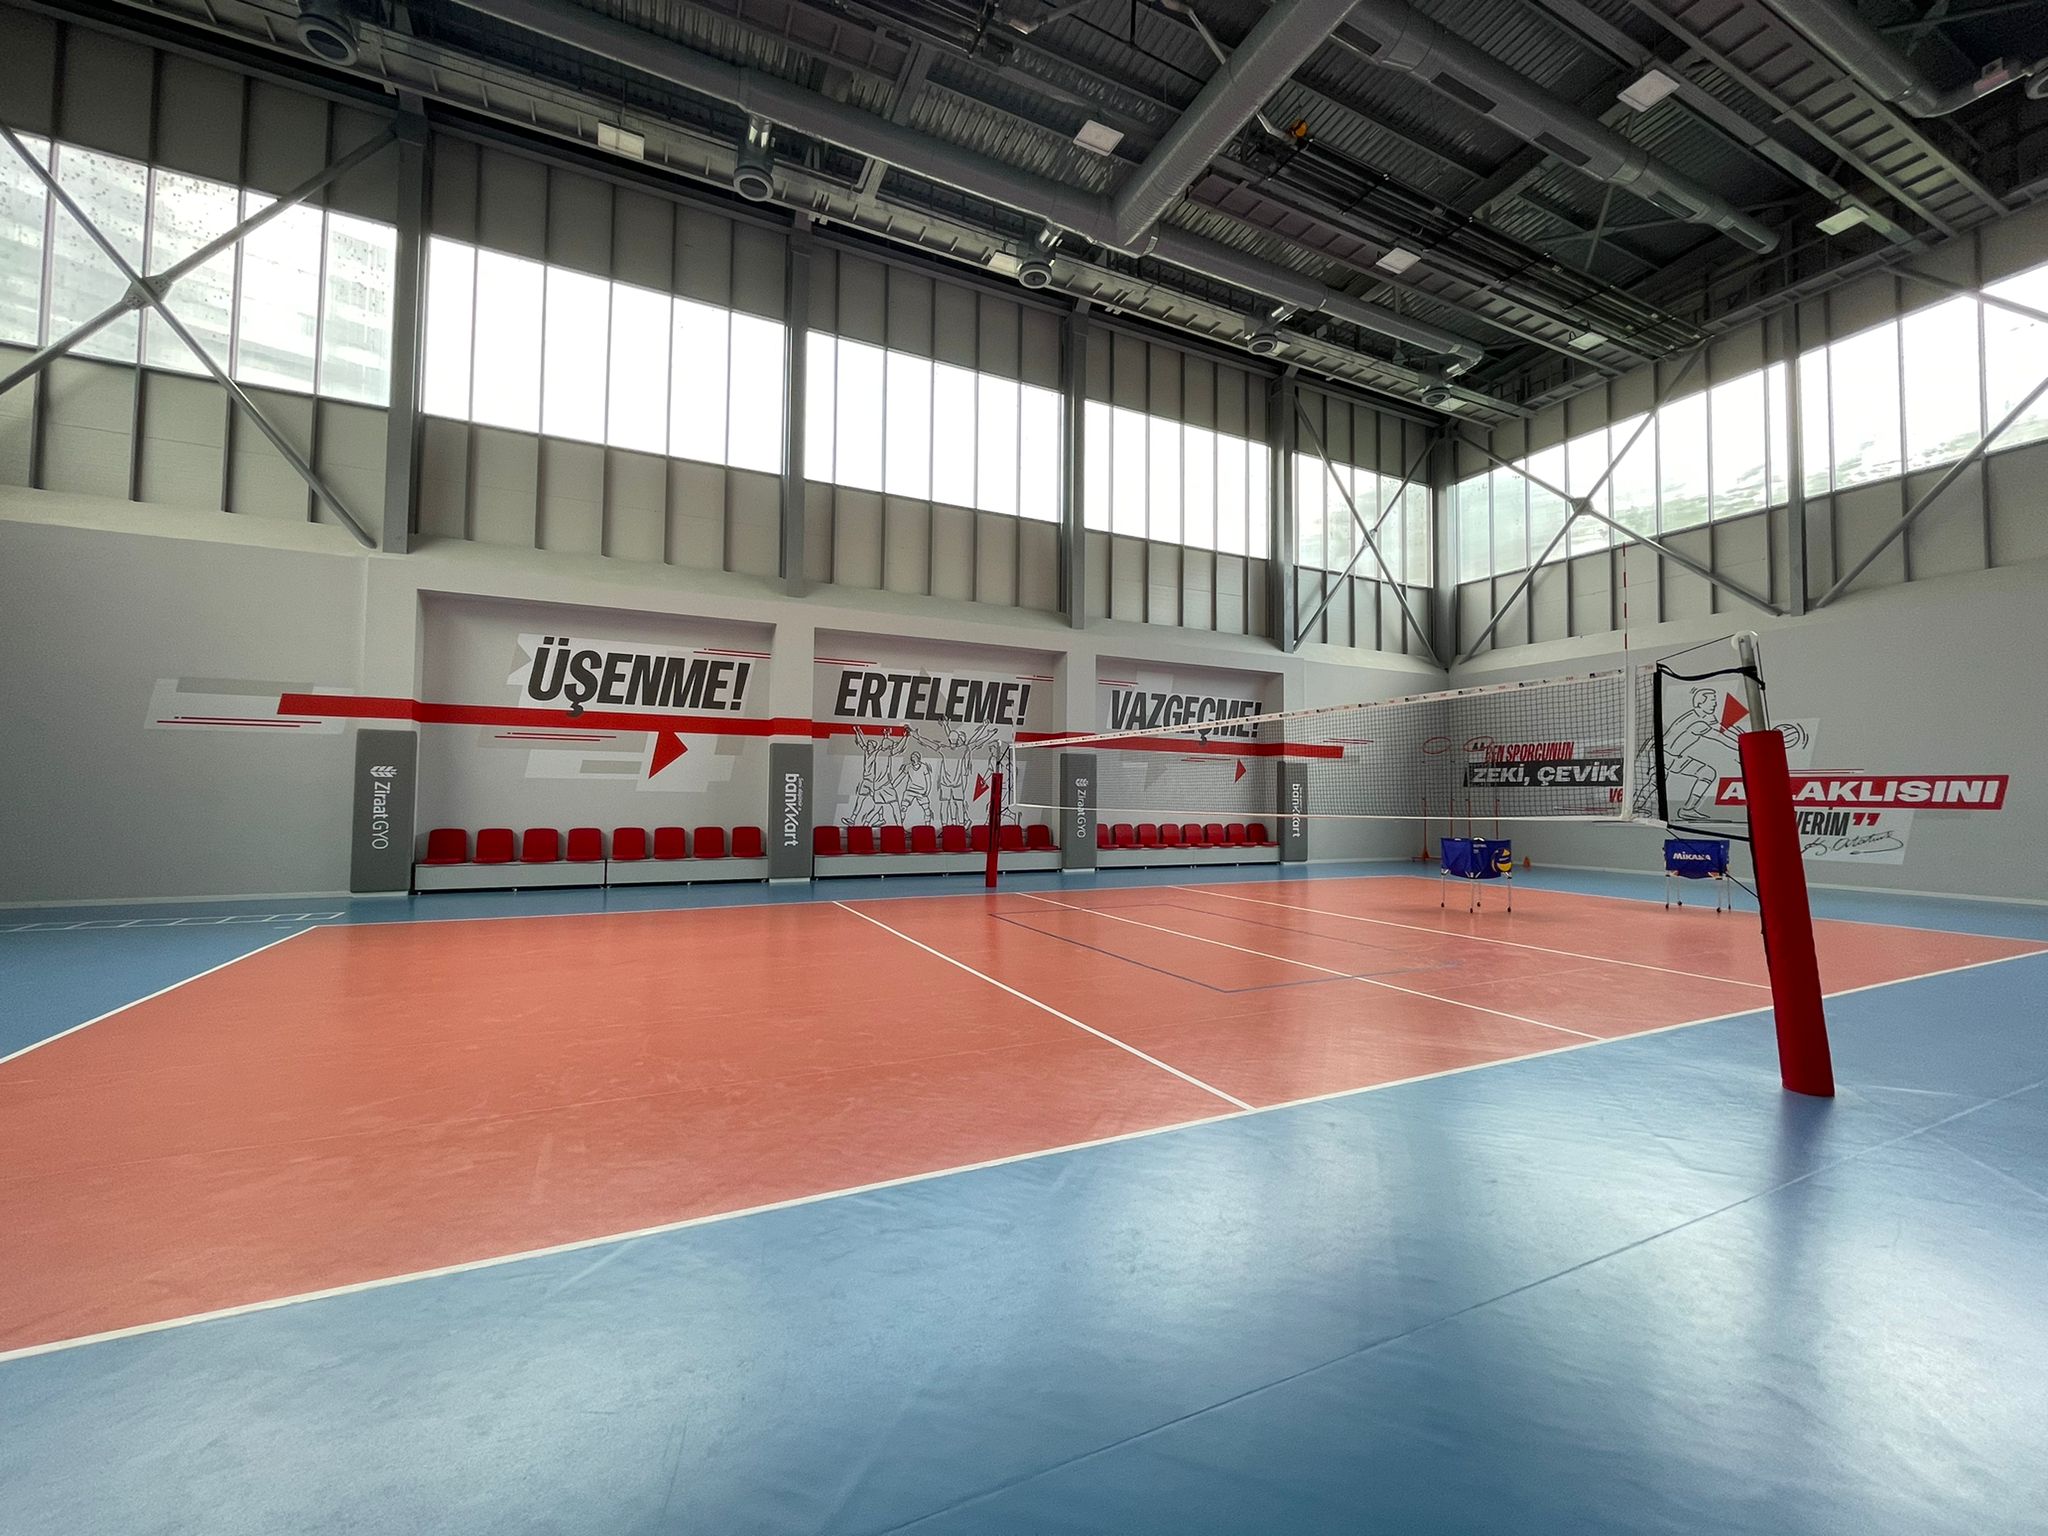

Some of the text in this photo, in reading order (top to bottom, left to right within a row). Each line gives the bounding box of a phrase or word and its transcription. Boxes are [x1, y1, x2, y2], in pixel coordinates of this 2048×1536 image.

[528, 636, 750, 717] ÜŞENME!
[834, 669, 1031, 725] ERTELEME!
[1111, 689, 1263, 745] VAZGEÇME!
[1506, 741, 1575, 762] SPORCUNUN
[1537, 761, 1621, 787] ÇEVİK
